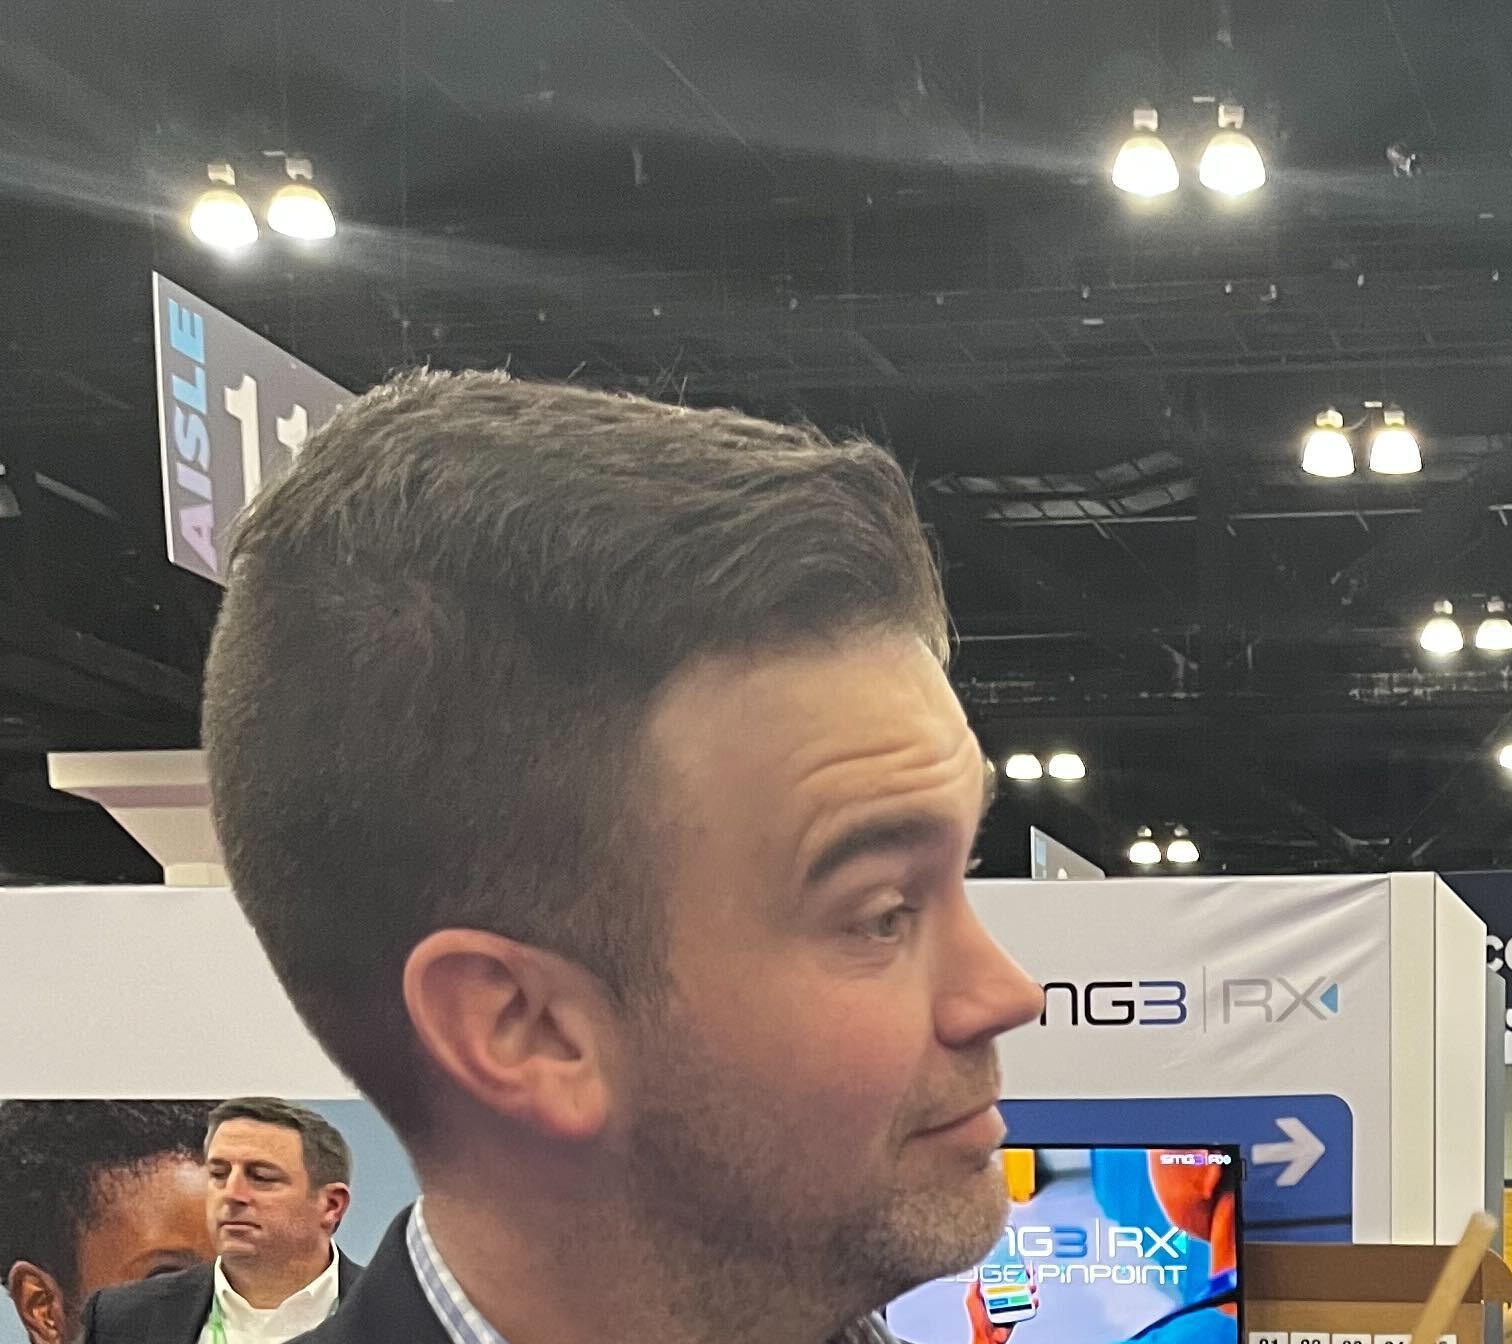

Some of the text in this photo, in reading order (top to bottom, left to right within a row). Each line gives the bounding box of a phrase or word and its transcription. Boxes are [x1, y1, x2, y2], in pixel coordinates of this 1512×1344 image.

[168, 298, 218, 574] AISLE
[1222, 976, 1328, 1024] RX
[1108, 1226, 1182, 1258] RX
